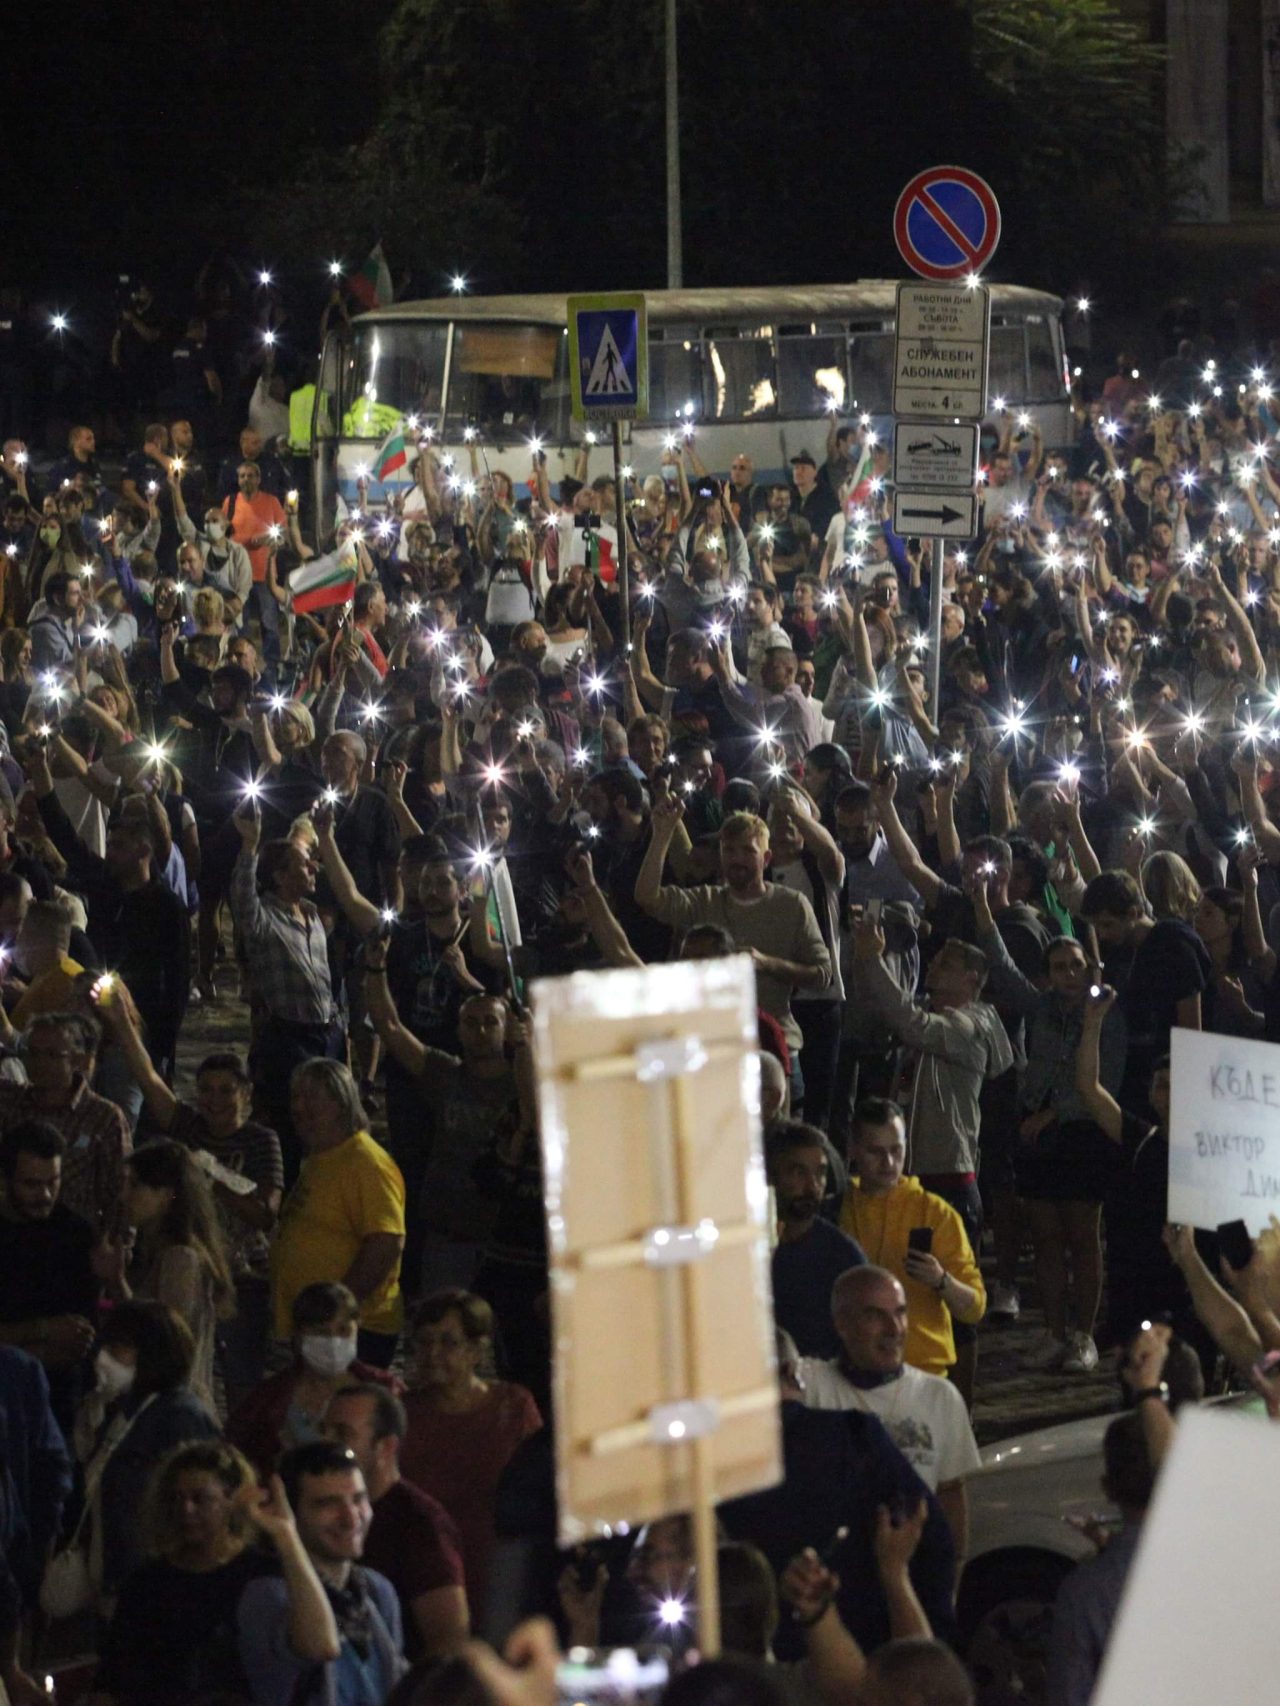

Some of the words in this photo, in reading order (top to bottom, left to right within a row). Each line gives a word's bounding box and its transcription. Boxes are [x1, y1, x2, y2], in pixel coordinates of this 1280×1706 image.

[907, 348, 974, 362] СЛУЖЕБЕН
[901, 366, 977, 380] АБОНАМЕНТ
[1209, 1064, 1280, 1109] КЪДЕ
[1194, 1131, 1266, 1161] ВИКТОР
